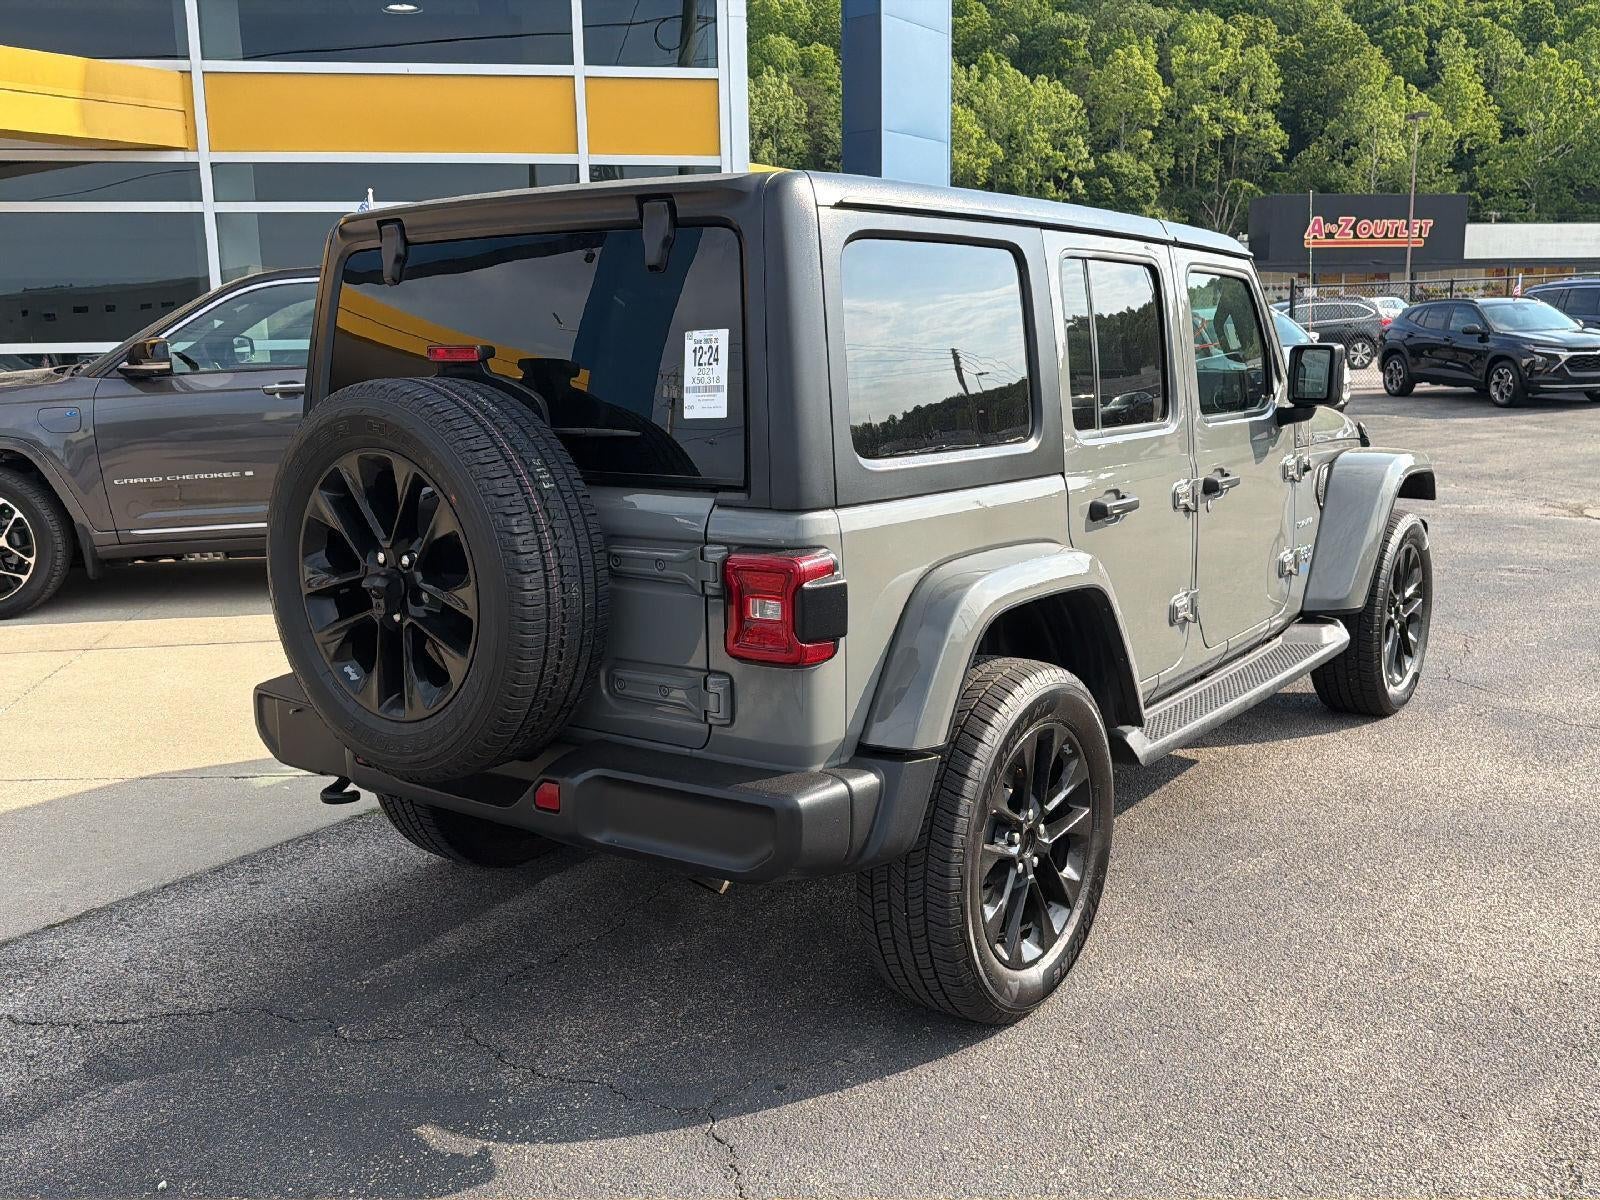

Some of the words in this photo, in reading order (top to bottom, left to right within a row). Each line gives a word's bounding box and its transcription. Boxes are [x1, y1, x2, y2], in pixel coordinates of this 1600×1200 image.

[1356, 219, 1433, 238] OUTLET
[692, 345, 719, 367] 12:24
[697, 367, 714, 376] 2021
[113, 476, 163, 485] GRAND
[166, 471, 242, 481] CHEROKEE
